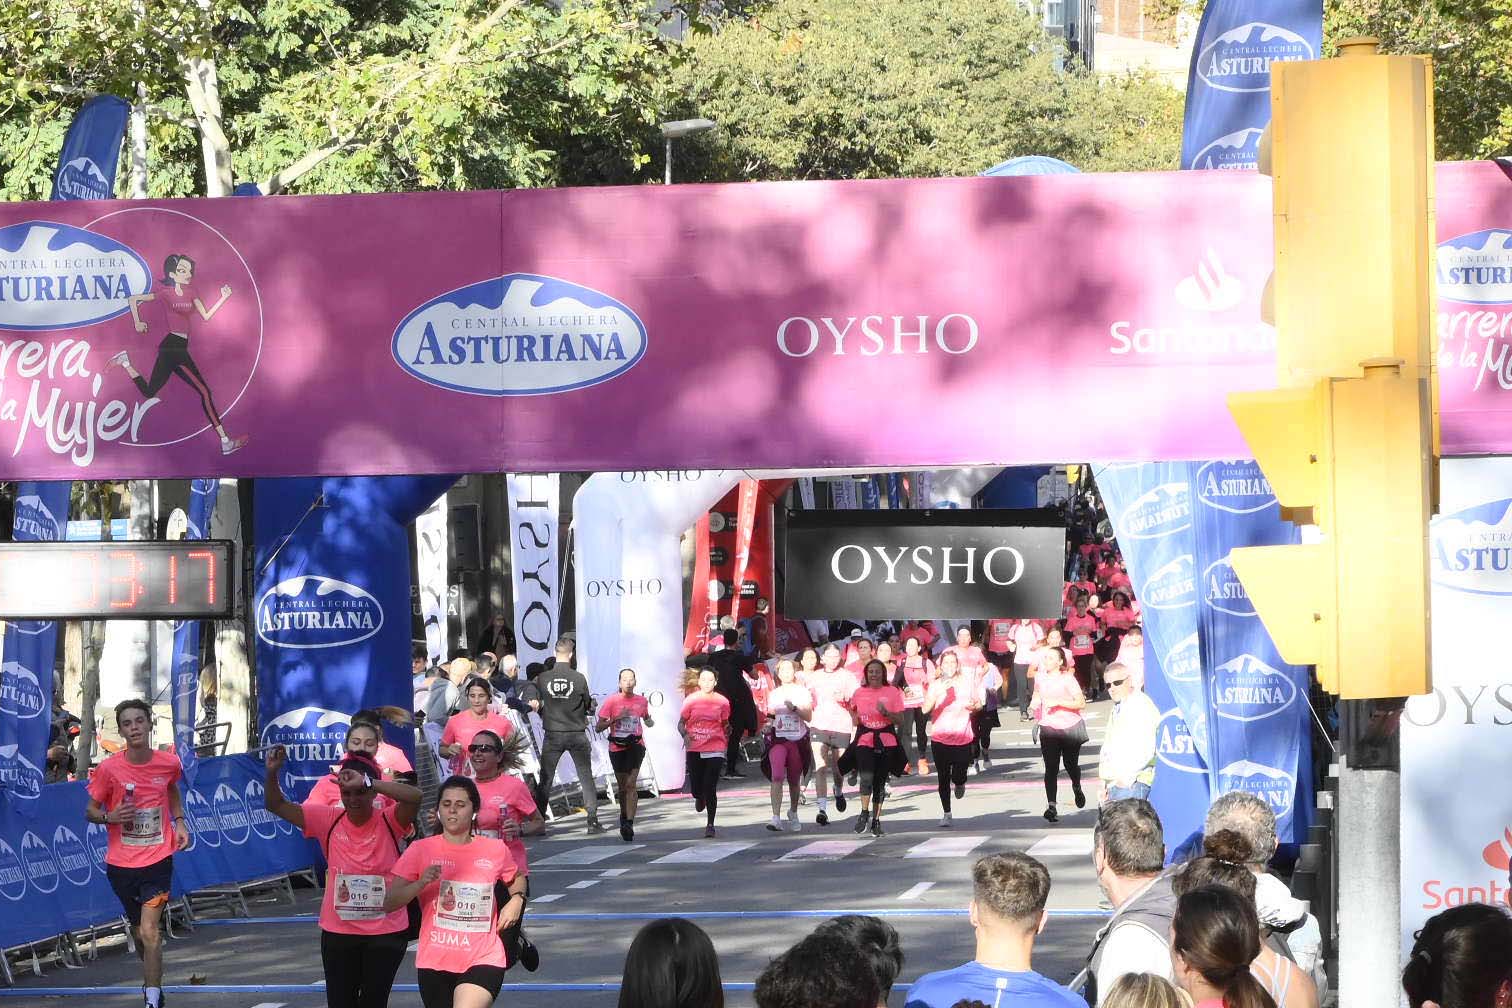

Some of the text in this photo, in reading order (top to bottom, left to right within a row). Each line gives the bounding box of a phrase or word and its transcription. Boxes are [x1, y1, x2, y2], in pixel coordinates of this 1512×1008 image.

[54, 257, 127, 269] LECHERA
[451, 315, 619, 330] CENTRAL LECHERA
[412, 320, 627, 365] ASTURIANA
[776, 313, 979, 357] OYSHO
[12, 373, 161, 467] Mujer
[831, 544, 1025, 585] OYSHO
[586, 578, 663, 598] OYSHO
[261, 605, 375, 632] ASTURIANA
[350, 892, 368, 900] 016
[457, 902, 476, 910] 016
[429, 931, 471, 947] SUMA
